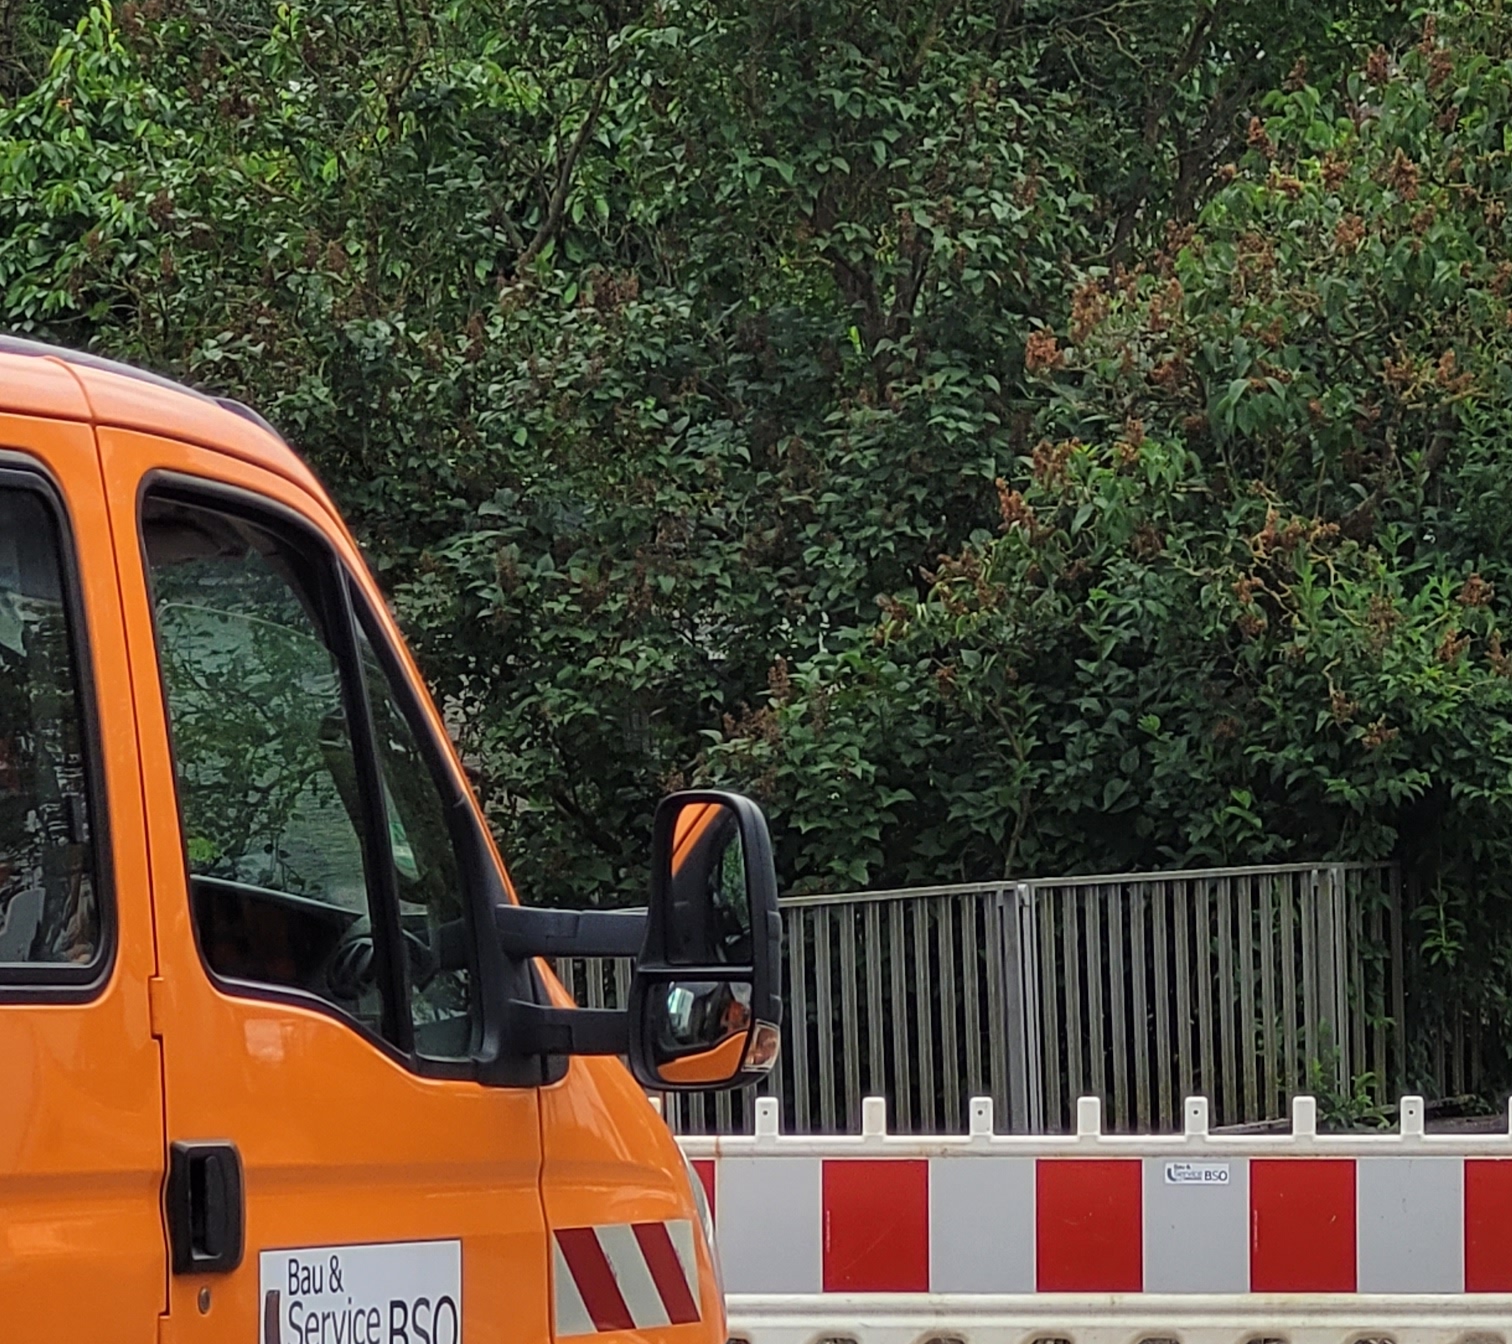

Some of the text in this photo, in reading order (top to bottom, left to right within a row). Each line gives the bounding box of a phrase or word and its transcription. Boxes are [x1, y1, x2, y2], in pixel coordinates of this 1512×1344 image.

[1204, 1170, 1228, 1181] BSO
[288, 1255, 344, 1296] Bau &
